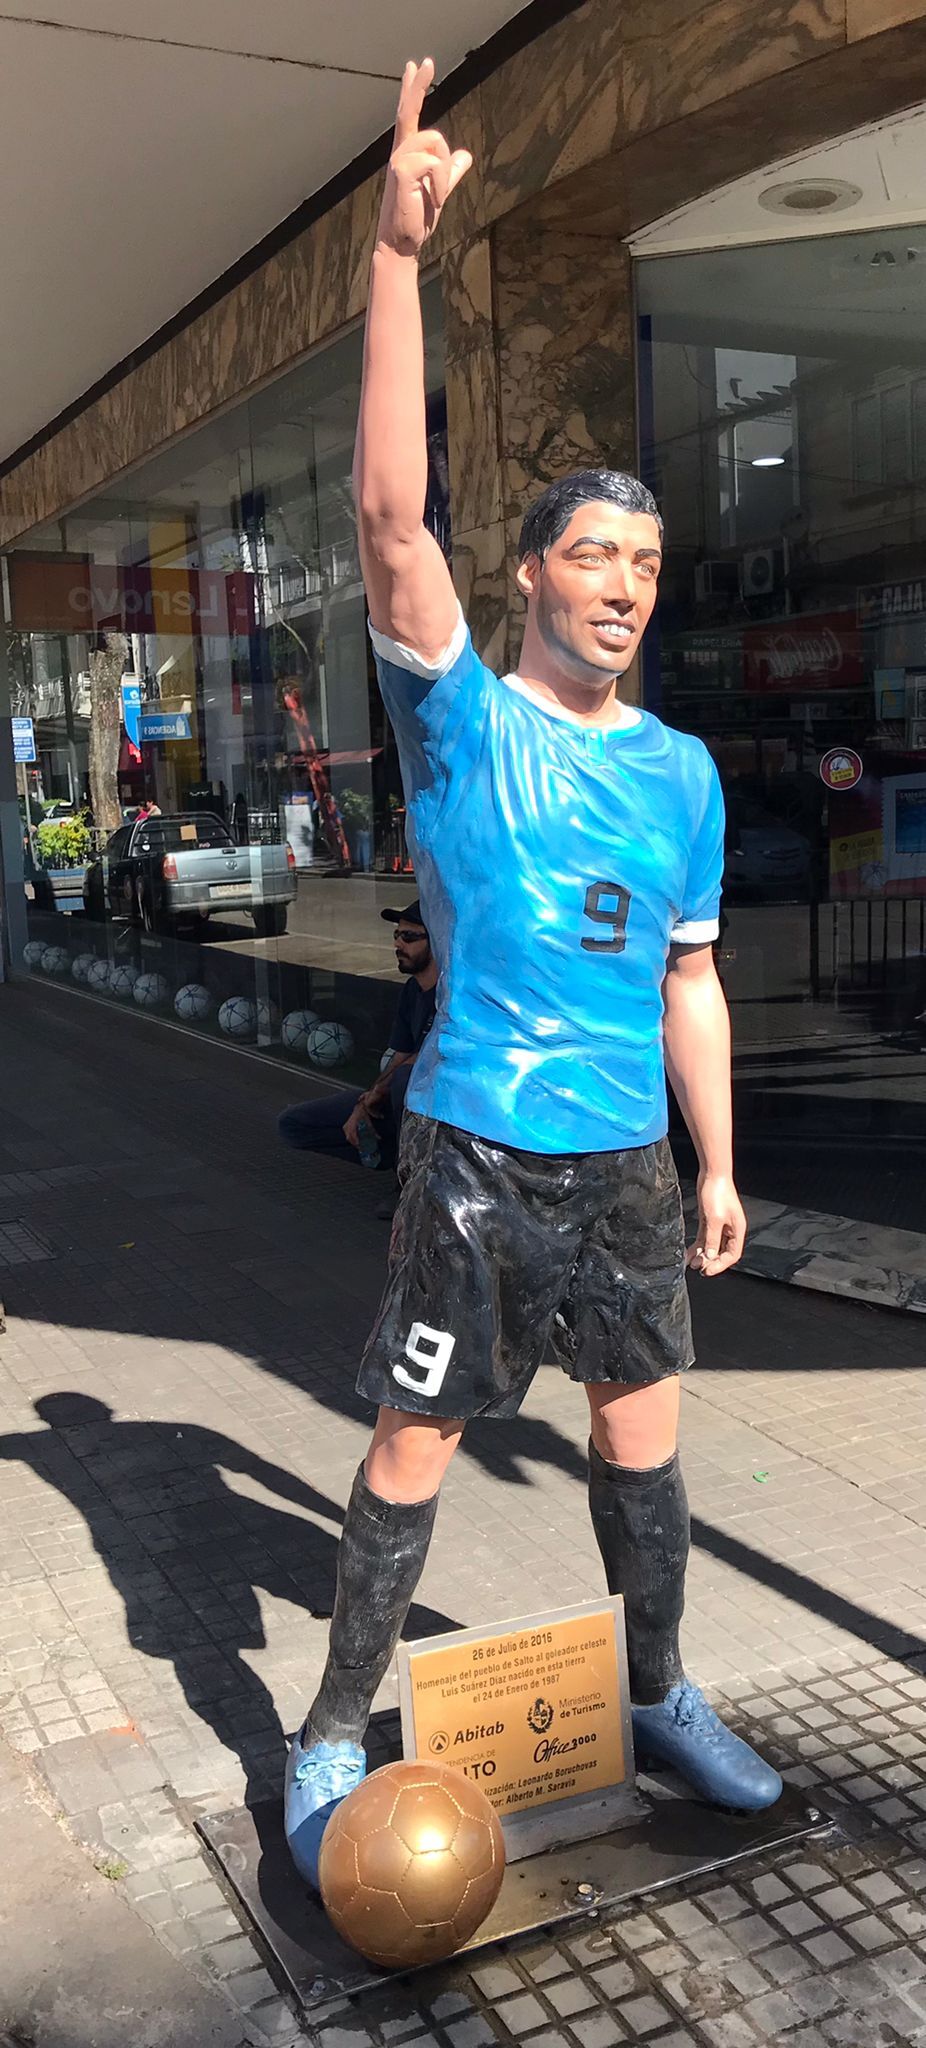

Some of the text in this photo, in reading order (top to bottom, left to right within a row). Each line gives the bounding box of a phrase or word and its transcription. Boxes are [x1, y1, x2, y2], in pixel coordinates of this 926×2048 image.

[579, 880, 632, 954] 9
[392, 1322, 457, 1398] 9
[472, 1632, 553, 1661] 26 de Julio de 2016
[416, 1637, 607, 1691] Homenaje del pueblo de Salto al goleador celeste
[441, 1686, 459, 1698] Luis
[460, 1680, 487, 1694] Suárez
[508, 1668, 534, 1682] nacido
[536, 1665, 546, 1675] en
[547, 1661, 563, 1673] esta
[565, 1656, 586, 1668] tierra
[473, 1673, 560, 1703] el 24 de Enero de 1987
[558, 1692, 602, 1709] Ministerio
[560, 1702, 606, 1719] de Turismo
[453, 1721, 505, 1746] Abitab
[485, 1748, 496, 1758] DE
[484, 1759, 598, 1797] lización: Leonardo Boruchovas
[505, 1791, 534, 1805] Alberto
[535, 1786, 546, 1796] M.
[547, 1778, 576, 1793] Saravia
